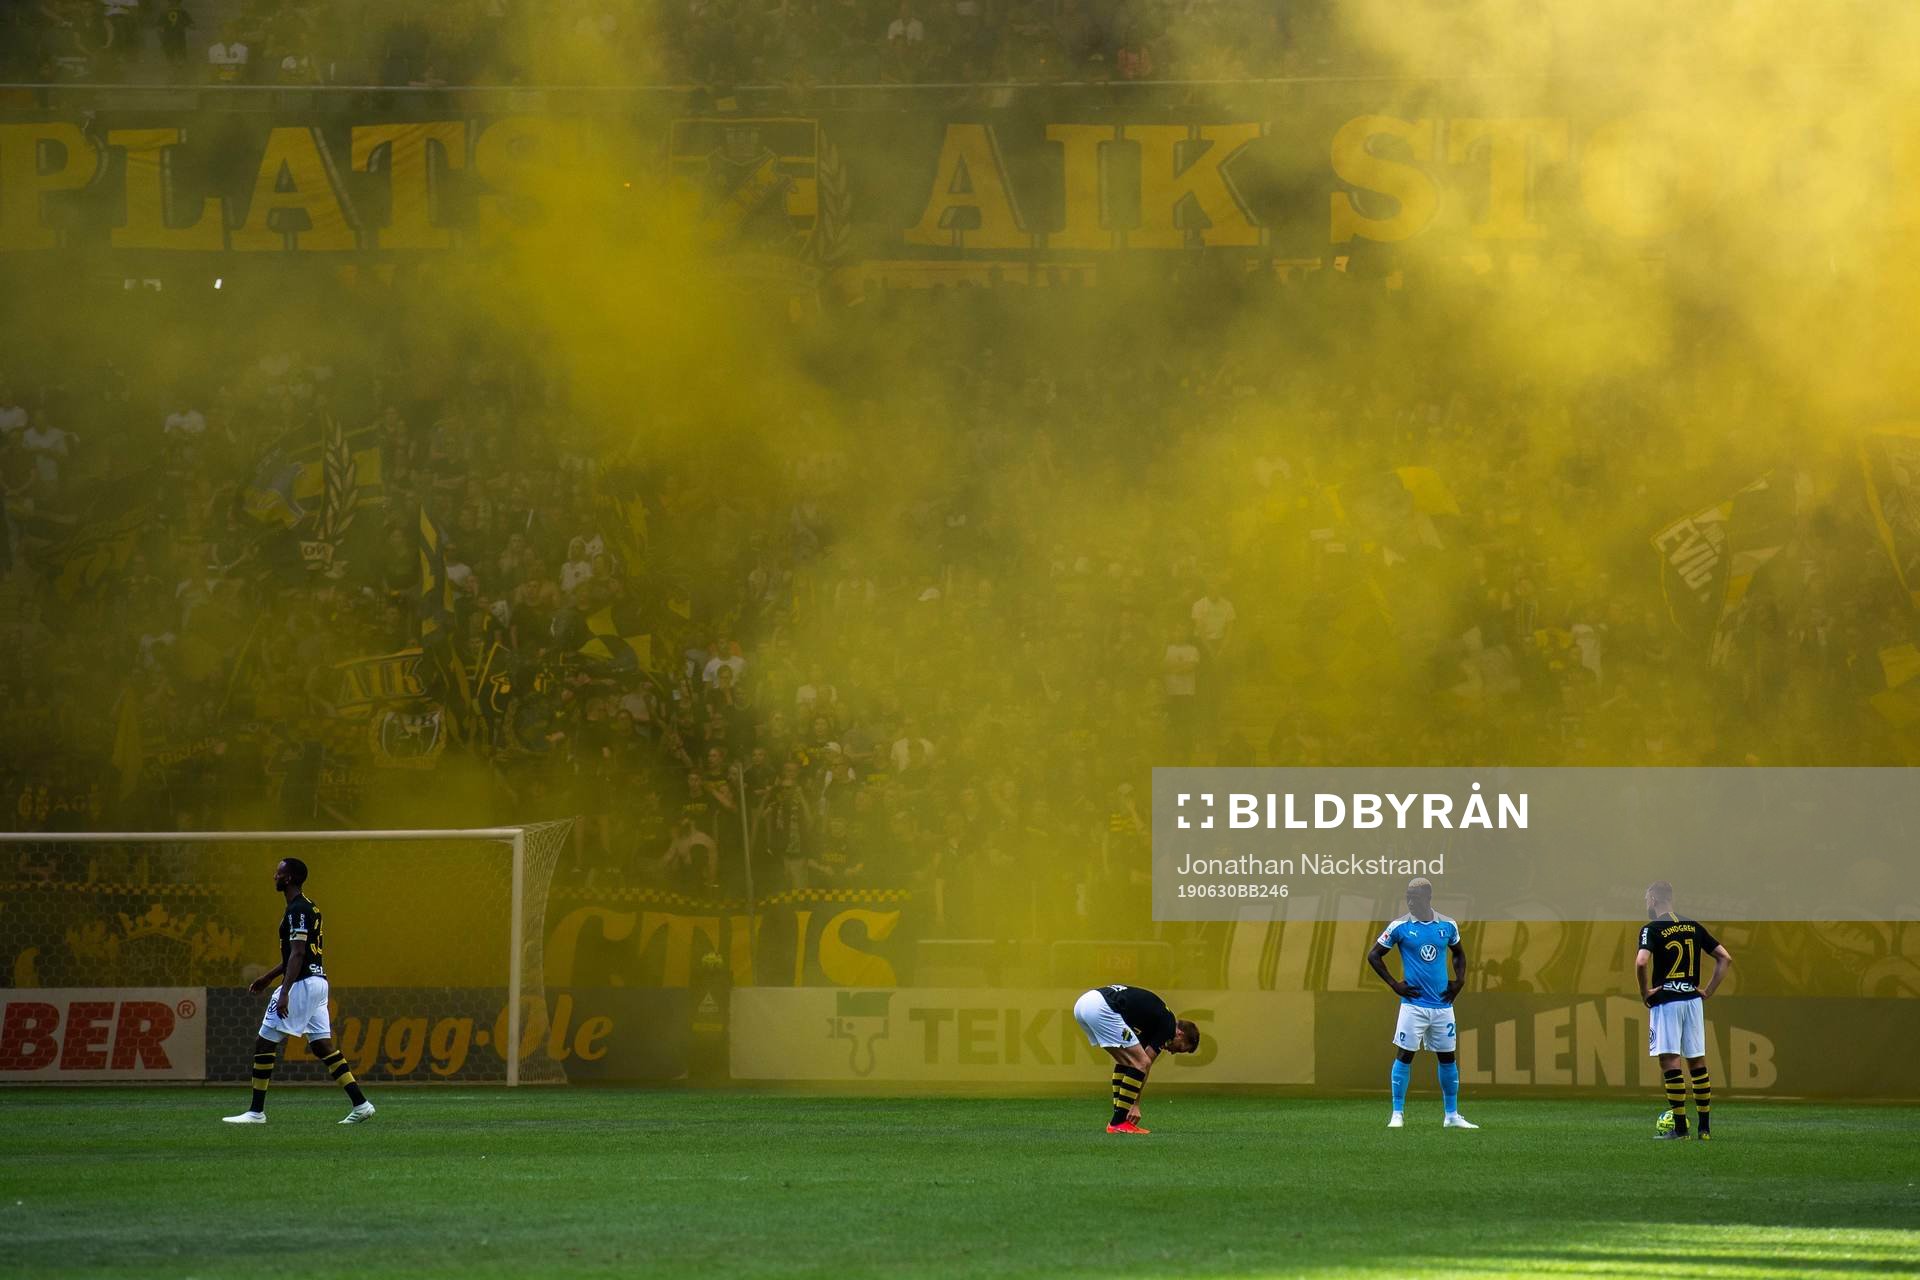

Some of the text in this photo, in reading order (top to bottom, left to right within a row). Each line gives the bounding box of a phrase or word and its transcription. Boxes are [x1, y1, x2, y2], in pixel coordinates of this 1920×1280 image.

[904, 123, 1264, 250] AIK
[1661, 924, 1696, 938] SUNDGREN
[1665, 938, 1695, 979] 21
[909, 1008, 1219, 1067] TEKNS
